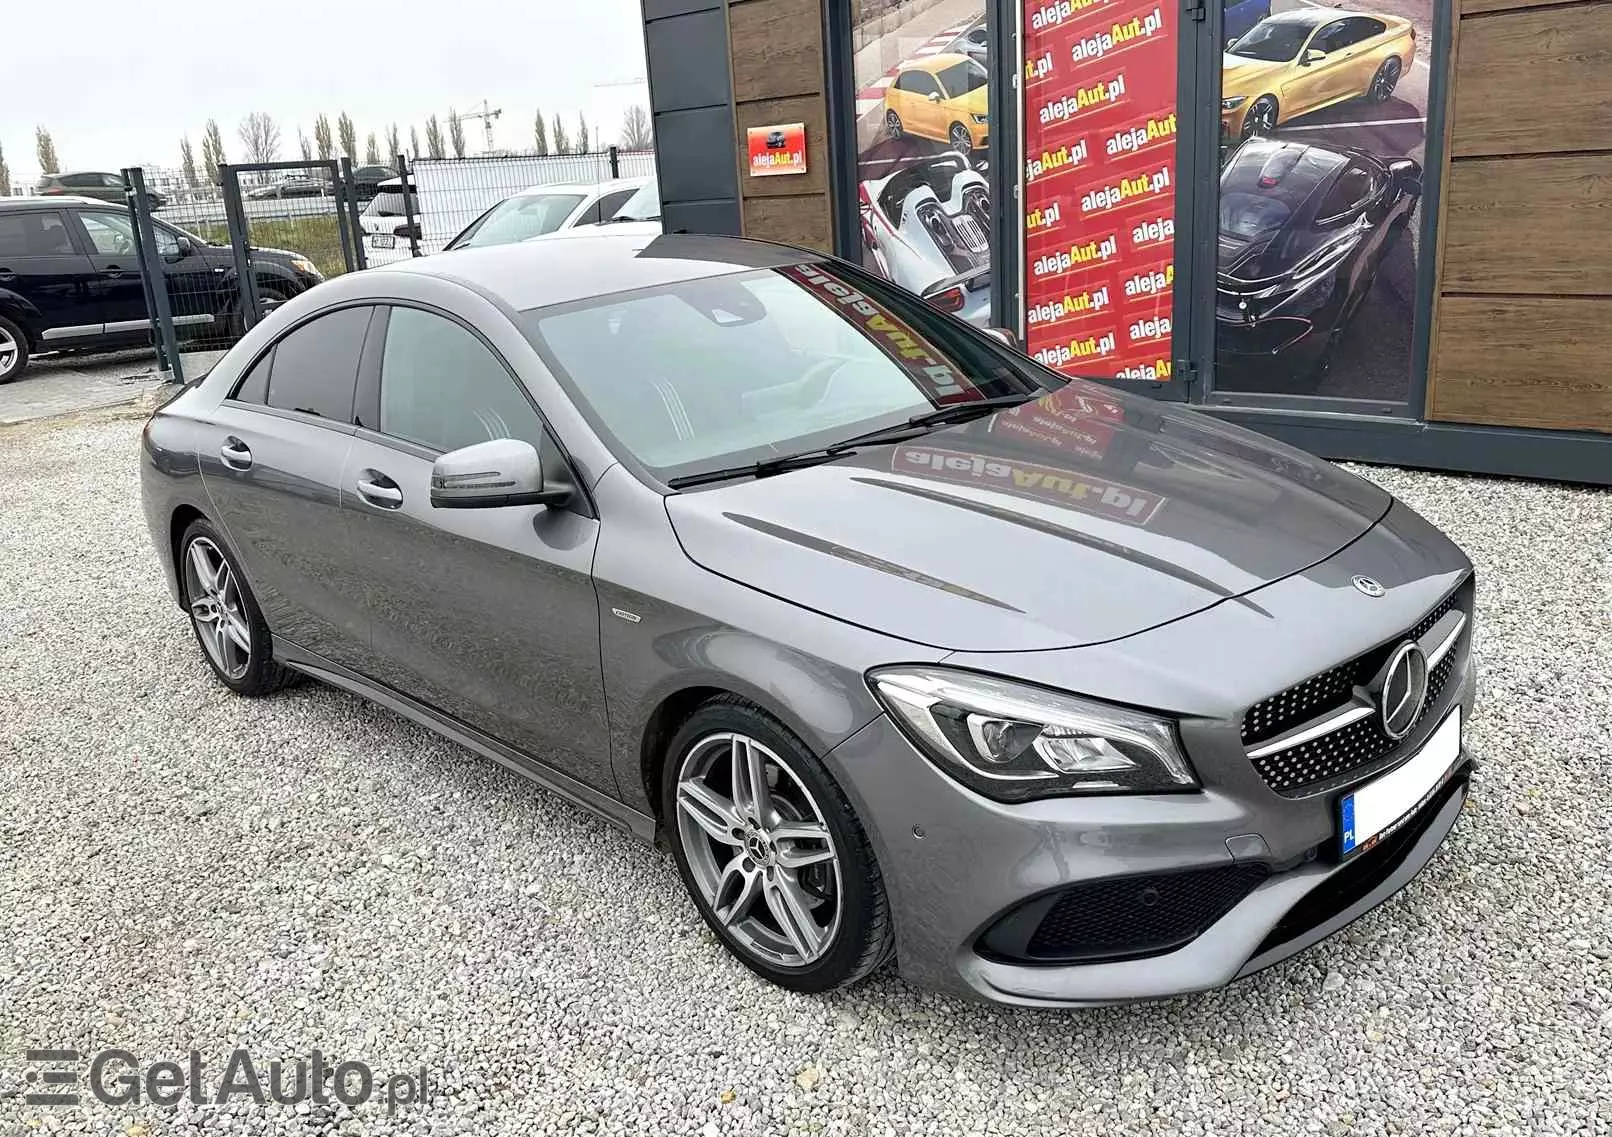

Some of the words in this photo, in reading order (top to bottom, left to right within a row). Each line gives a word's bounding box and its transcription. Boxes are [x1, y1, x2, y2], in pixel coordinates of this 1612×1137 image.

[1071, 8, 1162, 62] alejaAut.pl
[1039, 75, 1125, 124] alejaAut.pl
[753, 150, 802, 168] alejaAut.pl
[1081, 167, 1170, 212] alejaAut.pl
[1132, 218, 1175, 244] aleja
[1033, 235, 1117, 276] alejaAut.pl
[1028, 287, 1110, 324] alejaAut.pl
[1129, 312, 1173, 340] aleja
[1034, 332, 1116, 366] alejaAut.pl
[1344, 829, 1354, 843] PL
